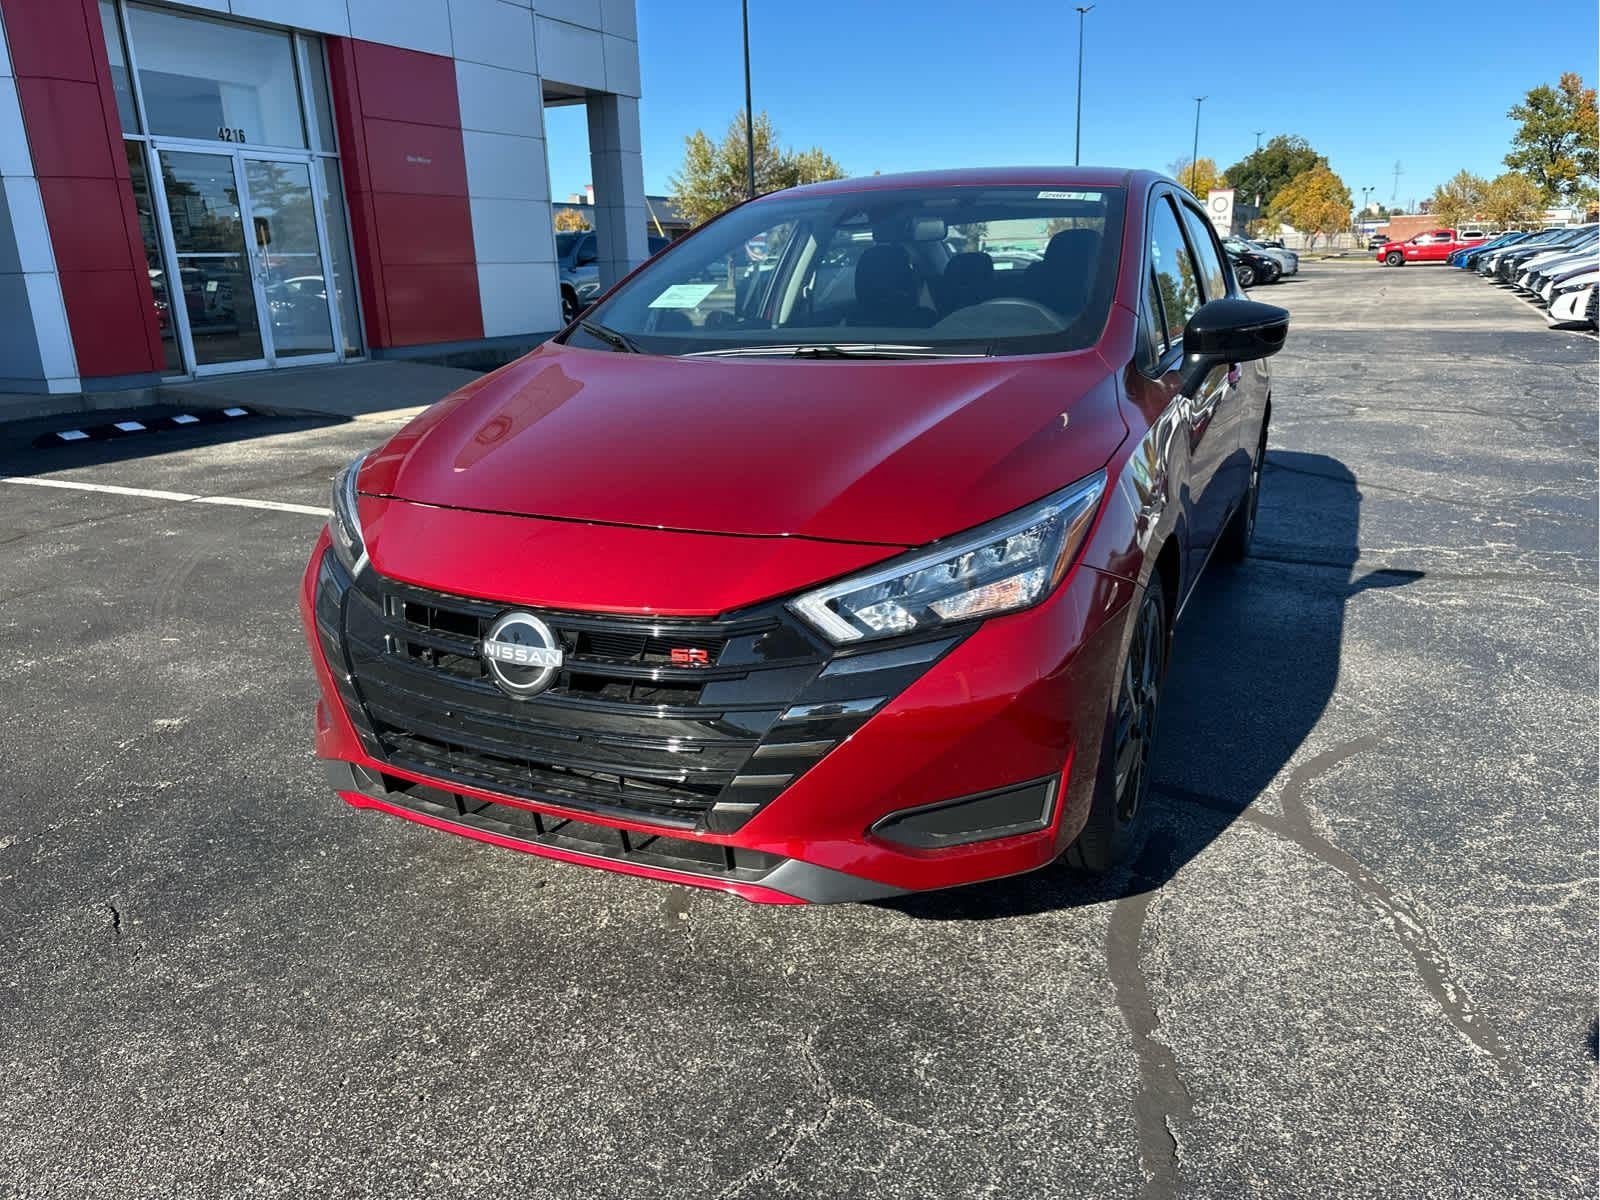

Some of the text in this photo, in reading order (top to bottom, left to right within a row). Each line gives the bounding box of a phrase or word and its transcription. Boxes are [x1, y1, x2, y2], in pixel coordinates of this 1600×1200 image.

[218, 127, 246, 143] 4216
[483, 640, 562, 666] NISSAN
[671, 648, 708, 665] SR
